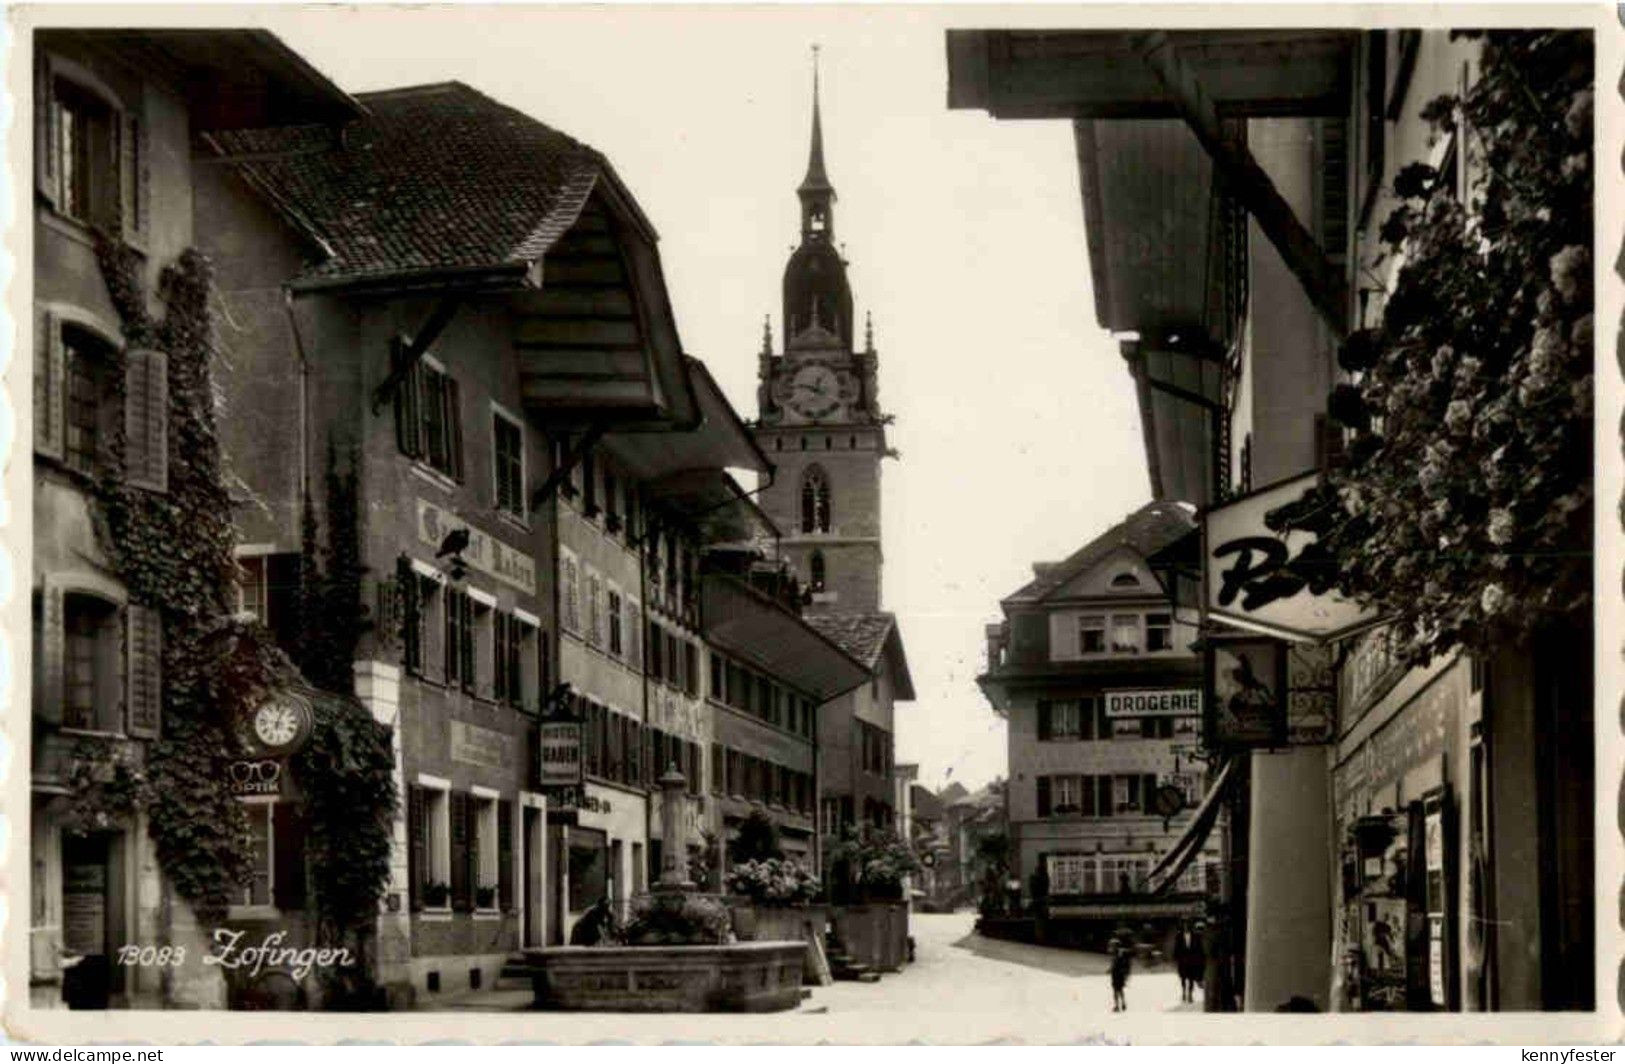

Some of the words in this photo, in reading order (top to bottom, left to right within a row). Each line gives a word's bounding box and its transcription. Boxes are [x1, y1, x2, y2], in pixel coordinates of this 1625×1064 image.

[1110, 693, 1199, 713] DROGERIE
[543, 746, 578, 763] RABEN
[230, 781, 280, 793] OPTIK
